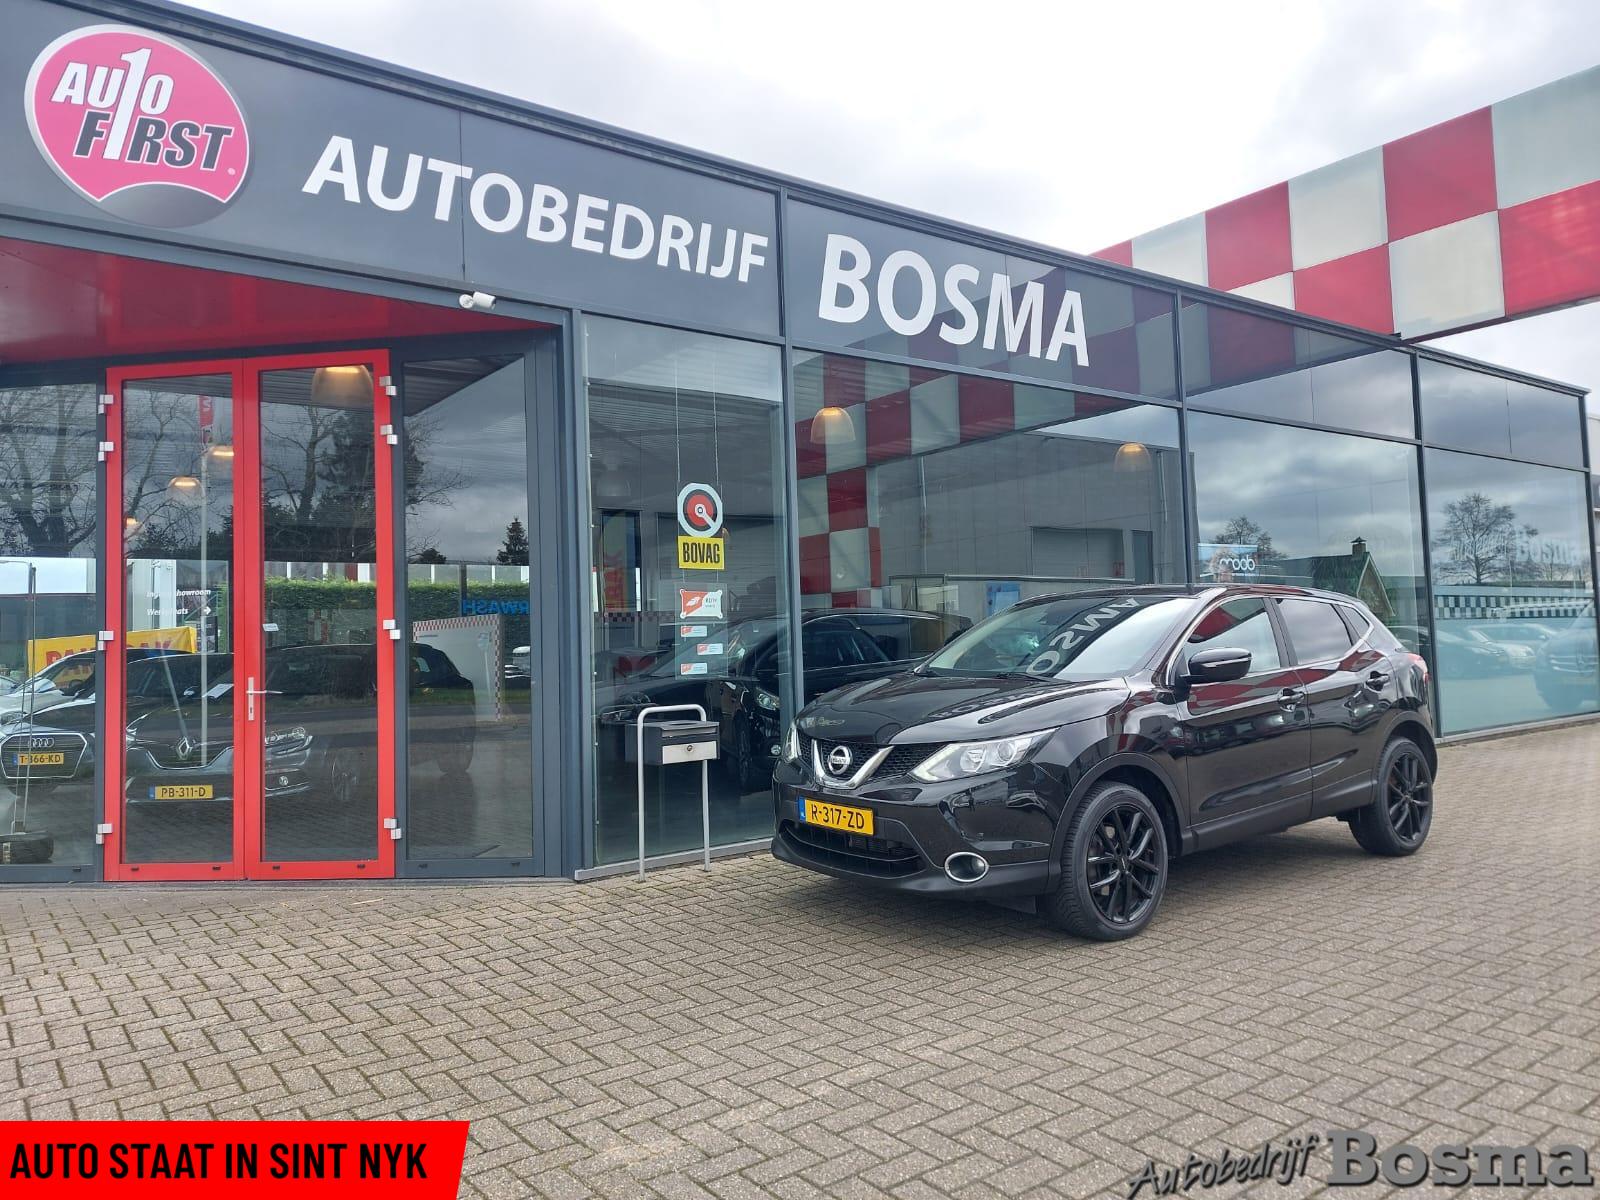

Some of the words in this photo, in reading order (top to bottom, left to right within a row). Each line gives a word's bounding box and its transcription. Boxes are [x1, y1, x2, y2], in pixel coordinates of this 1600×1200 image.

[302, 135, 769, 284] AUTOBEDRIJF
[818, 233, 1090, 367] BOSMA
[682, 542, 720, 564] BOVAG
[161, 786, 207, 798] PB-311-D
[810, 803, 865, 829] R-317-ZD
